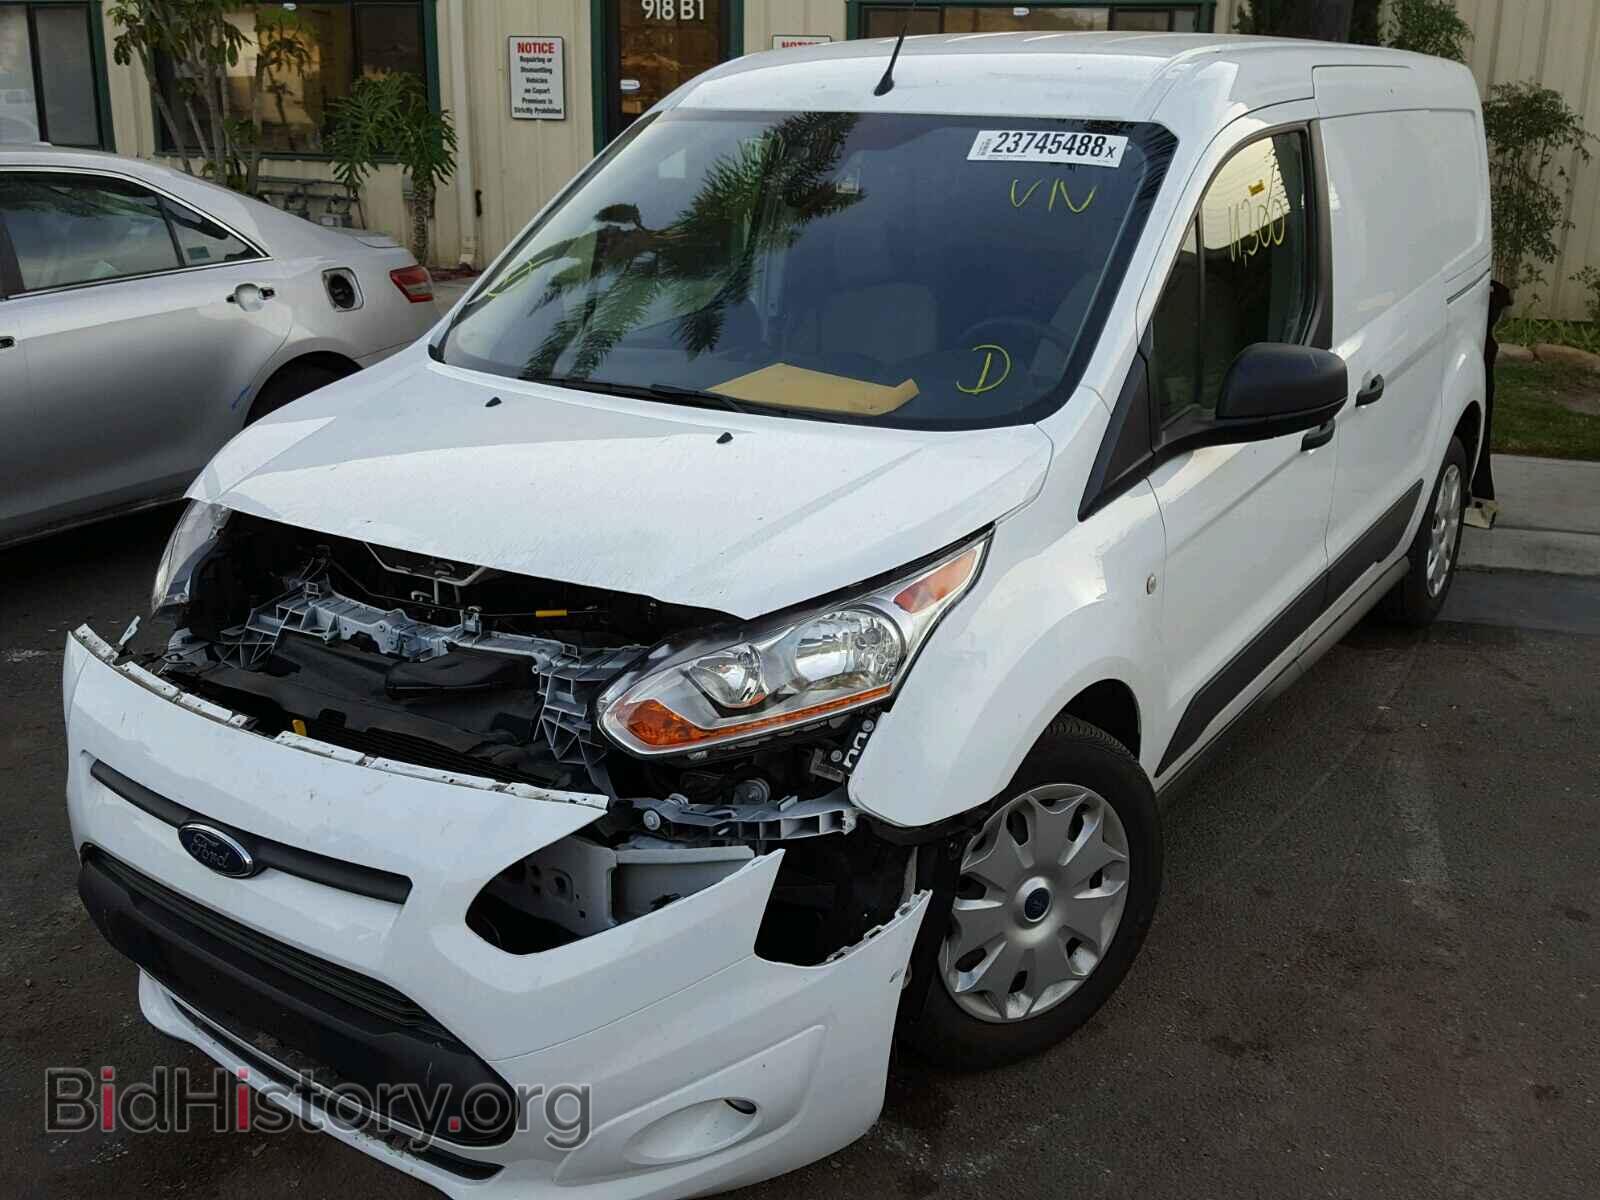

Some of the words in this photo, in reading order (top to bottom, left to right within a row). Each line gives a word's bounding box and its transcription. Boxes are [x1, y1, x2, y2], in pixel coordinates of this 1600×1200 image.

[641, 0, 675, 20] 918
[680, 0, 705, 20] B1
[517, 42, 556, 54] NOTICE
[519, 55, 546, 64] Repairing
[520, 66, 553, 75] Dismantling
[514, 106, 533, 115] Strictly
[534, 106, 562, 114] Prohibited
[955, 344, 1011, 395] D
[191, 833, 231, 869] Ford
